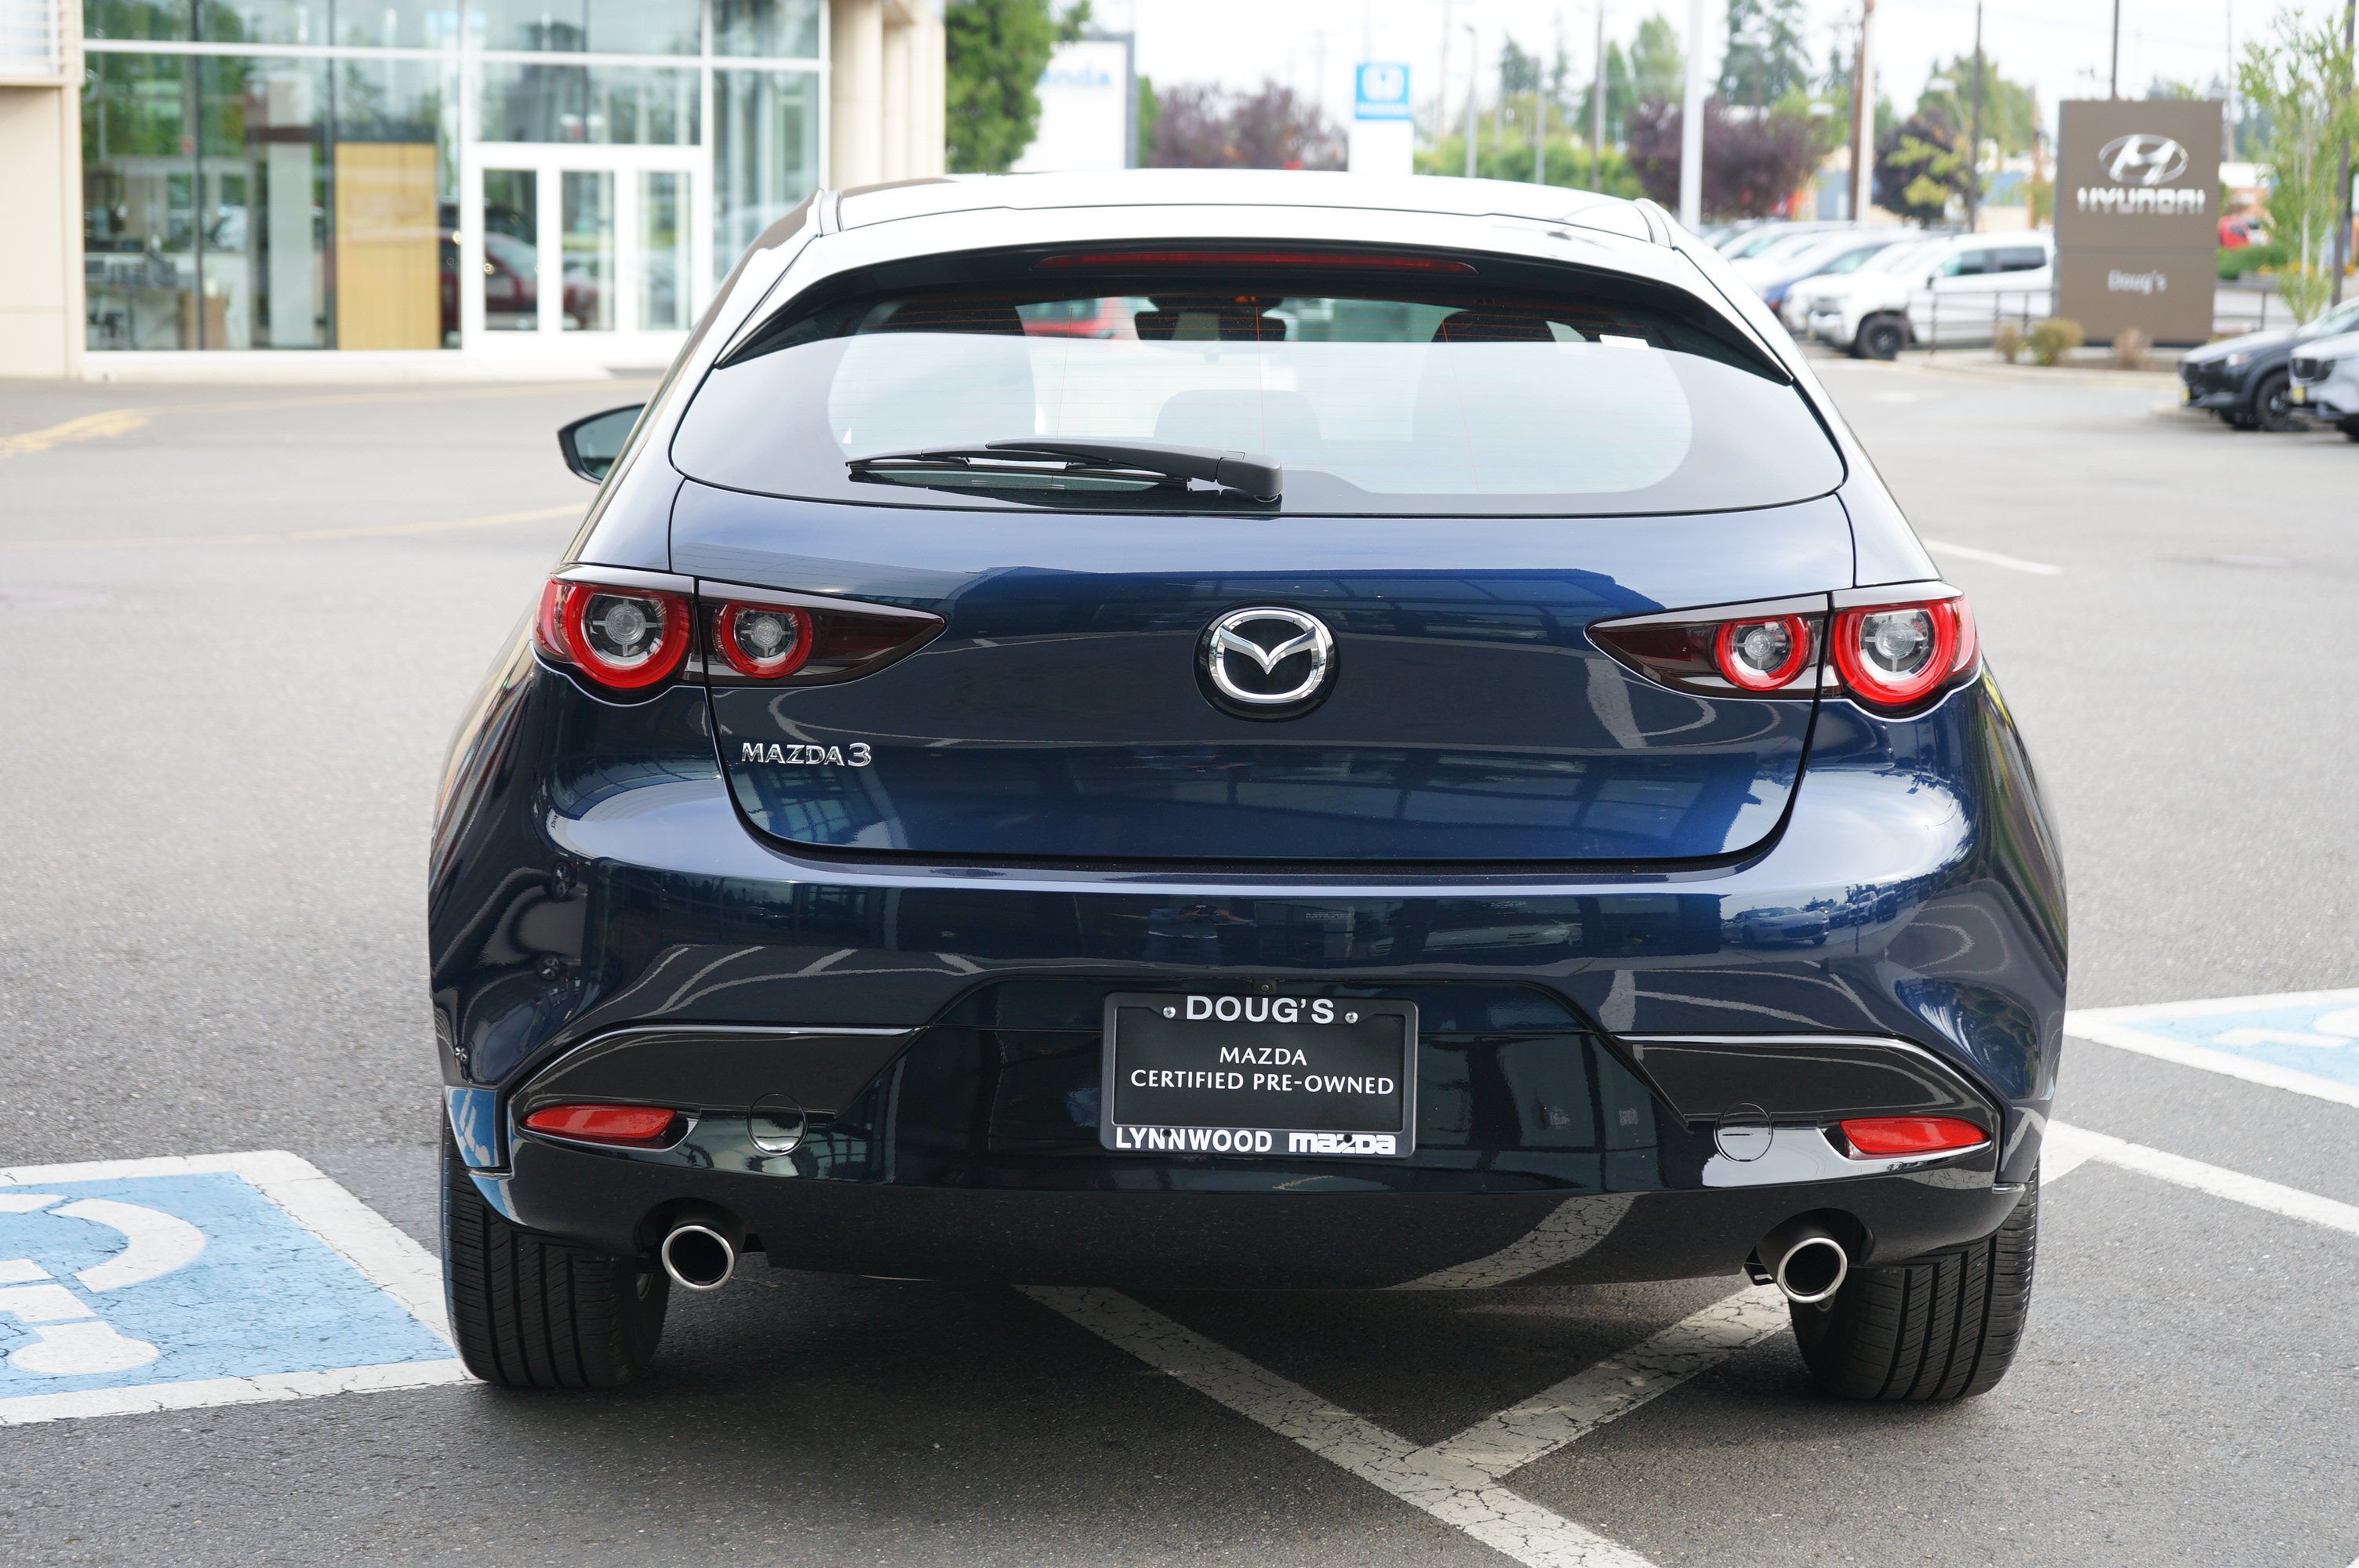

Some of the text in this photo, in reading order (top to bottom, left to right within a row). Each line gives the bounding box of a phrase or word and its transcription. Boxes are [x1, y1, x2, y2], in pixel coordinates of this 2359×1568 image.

[2077, 187, 2206, 215] HYUNDAI
[2108, 270, 2168, 296] Doug's
[1187, 995, 1335, 1025] DOUG'S
[1219, 1047, 1307, 1066] MAZDA
[1130, 1069, 1394, 1095] CERTIFIED PRE-OWNED
[1115, 1127, 1273, 1152] LYNNWOOD
